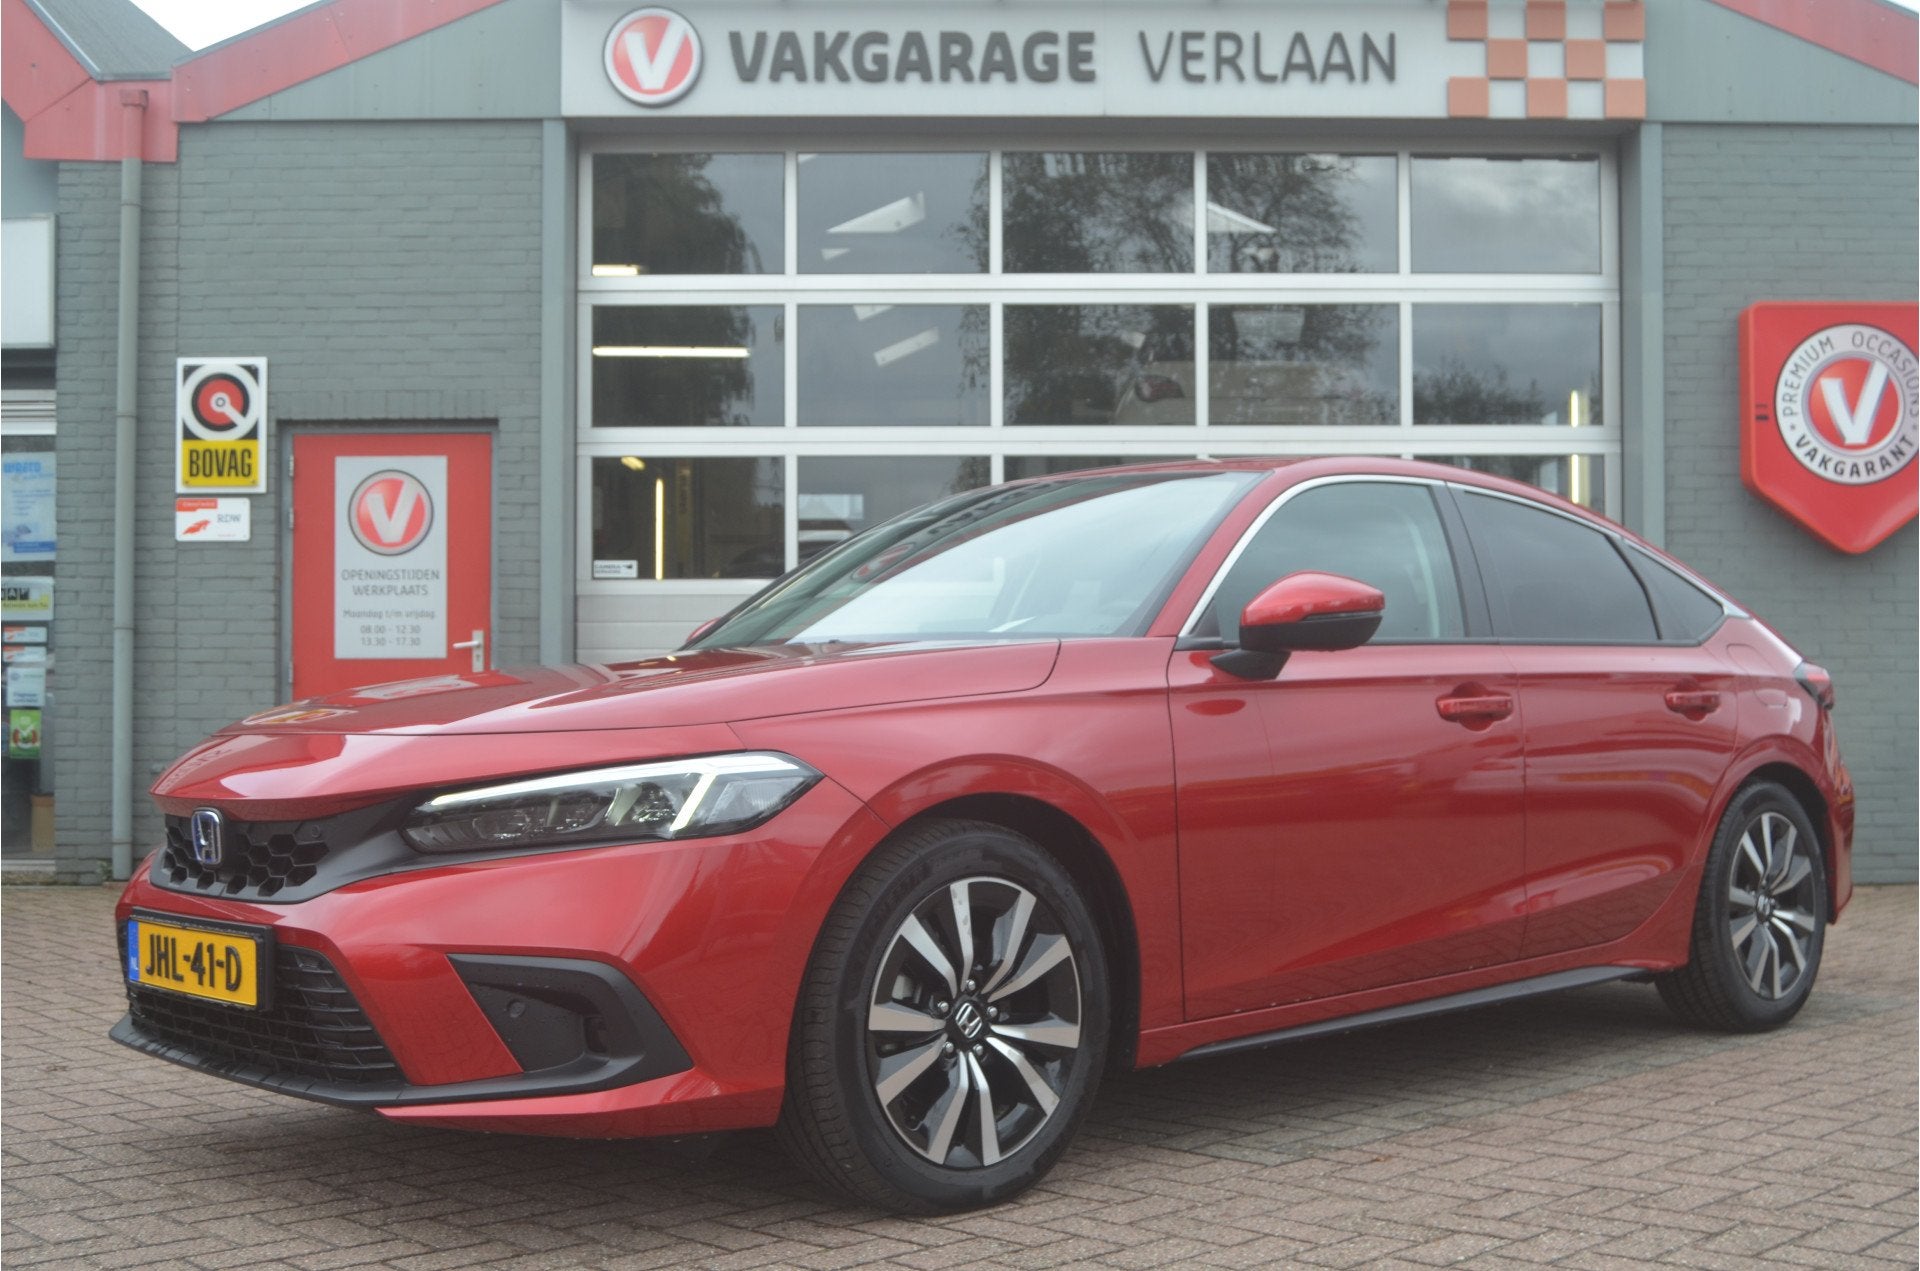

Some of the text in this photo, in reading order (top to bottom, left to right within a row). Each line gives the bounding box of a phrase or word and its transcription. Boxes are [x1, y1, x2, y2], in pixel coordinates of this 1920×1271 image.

[728, 30, 1397, 83] VAKGARAGE VERLAAN
[1782, 330, 1919, 418] PREMIUM OCCASIONS
[1819, 358, 1890, 445] V
[188, 448, 253, 478] BOVAG
[1795, 434, 1916, 478] VAKGARANT
[341, 569, 439, 581] OPENINGSTIJDEN
[352, 585, 429, 596] WERKPLAATS
[343, 609, 383, 620] Maandag
[145, 933, 242, 992] JHL-41-D
